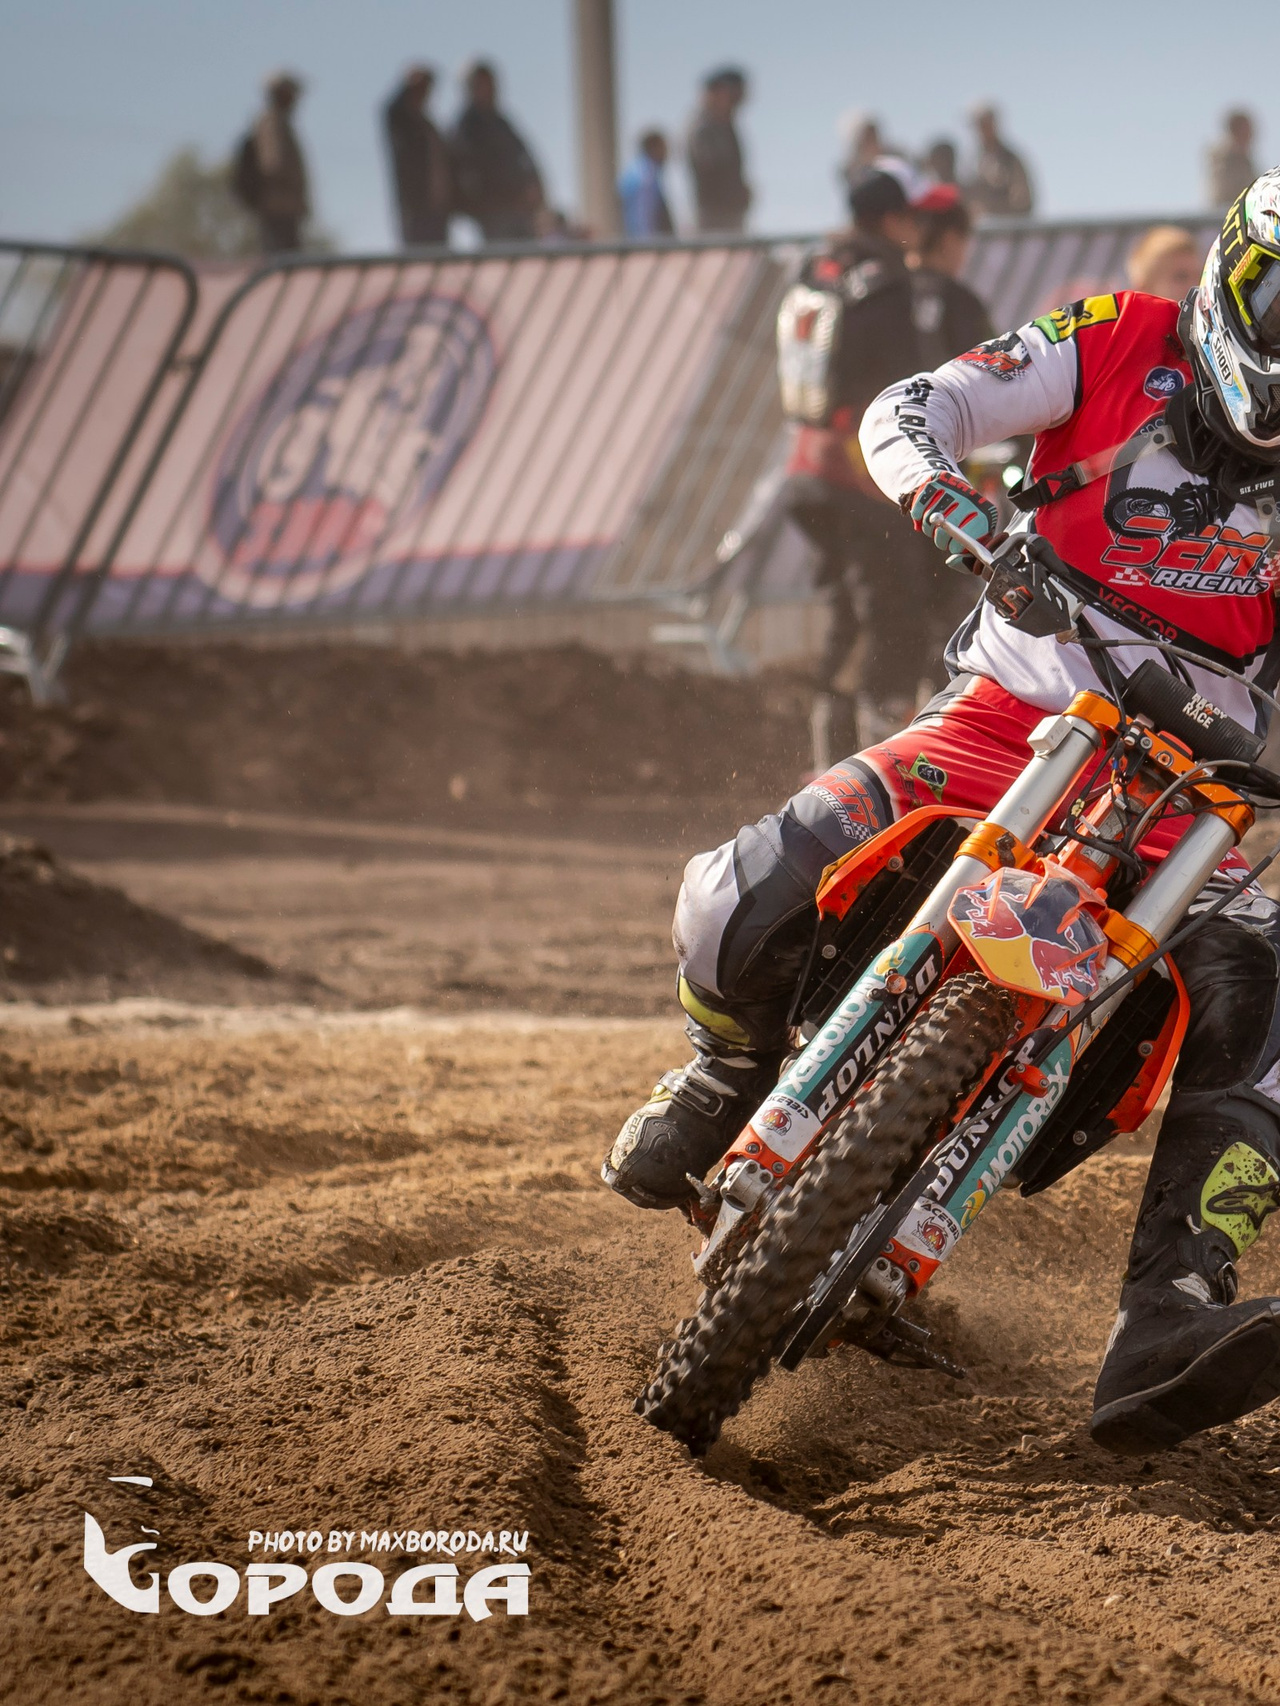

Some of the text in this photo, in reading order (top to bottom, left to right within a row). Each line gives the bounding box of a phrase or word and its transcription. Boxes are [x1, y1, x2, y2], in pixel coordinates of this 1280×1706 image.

[1213, 336, 1232, 381] SHOEI
[1101, 514, 1273, 578] SEM
[1151, 570, 1266, 595] RACING
[1182, 702, 1214, 729] RACE
[779, 976, 888, 1094] MOTOREX
[816, 953, 939, 1121] DUNLOP
[927, 1037, 1036, 1201] DUNLOP
[979, 1061, 1070, 1196] MOTOREX
[920, 1202, 960, 1240] ACERBIS
